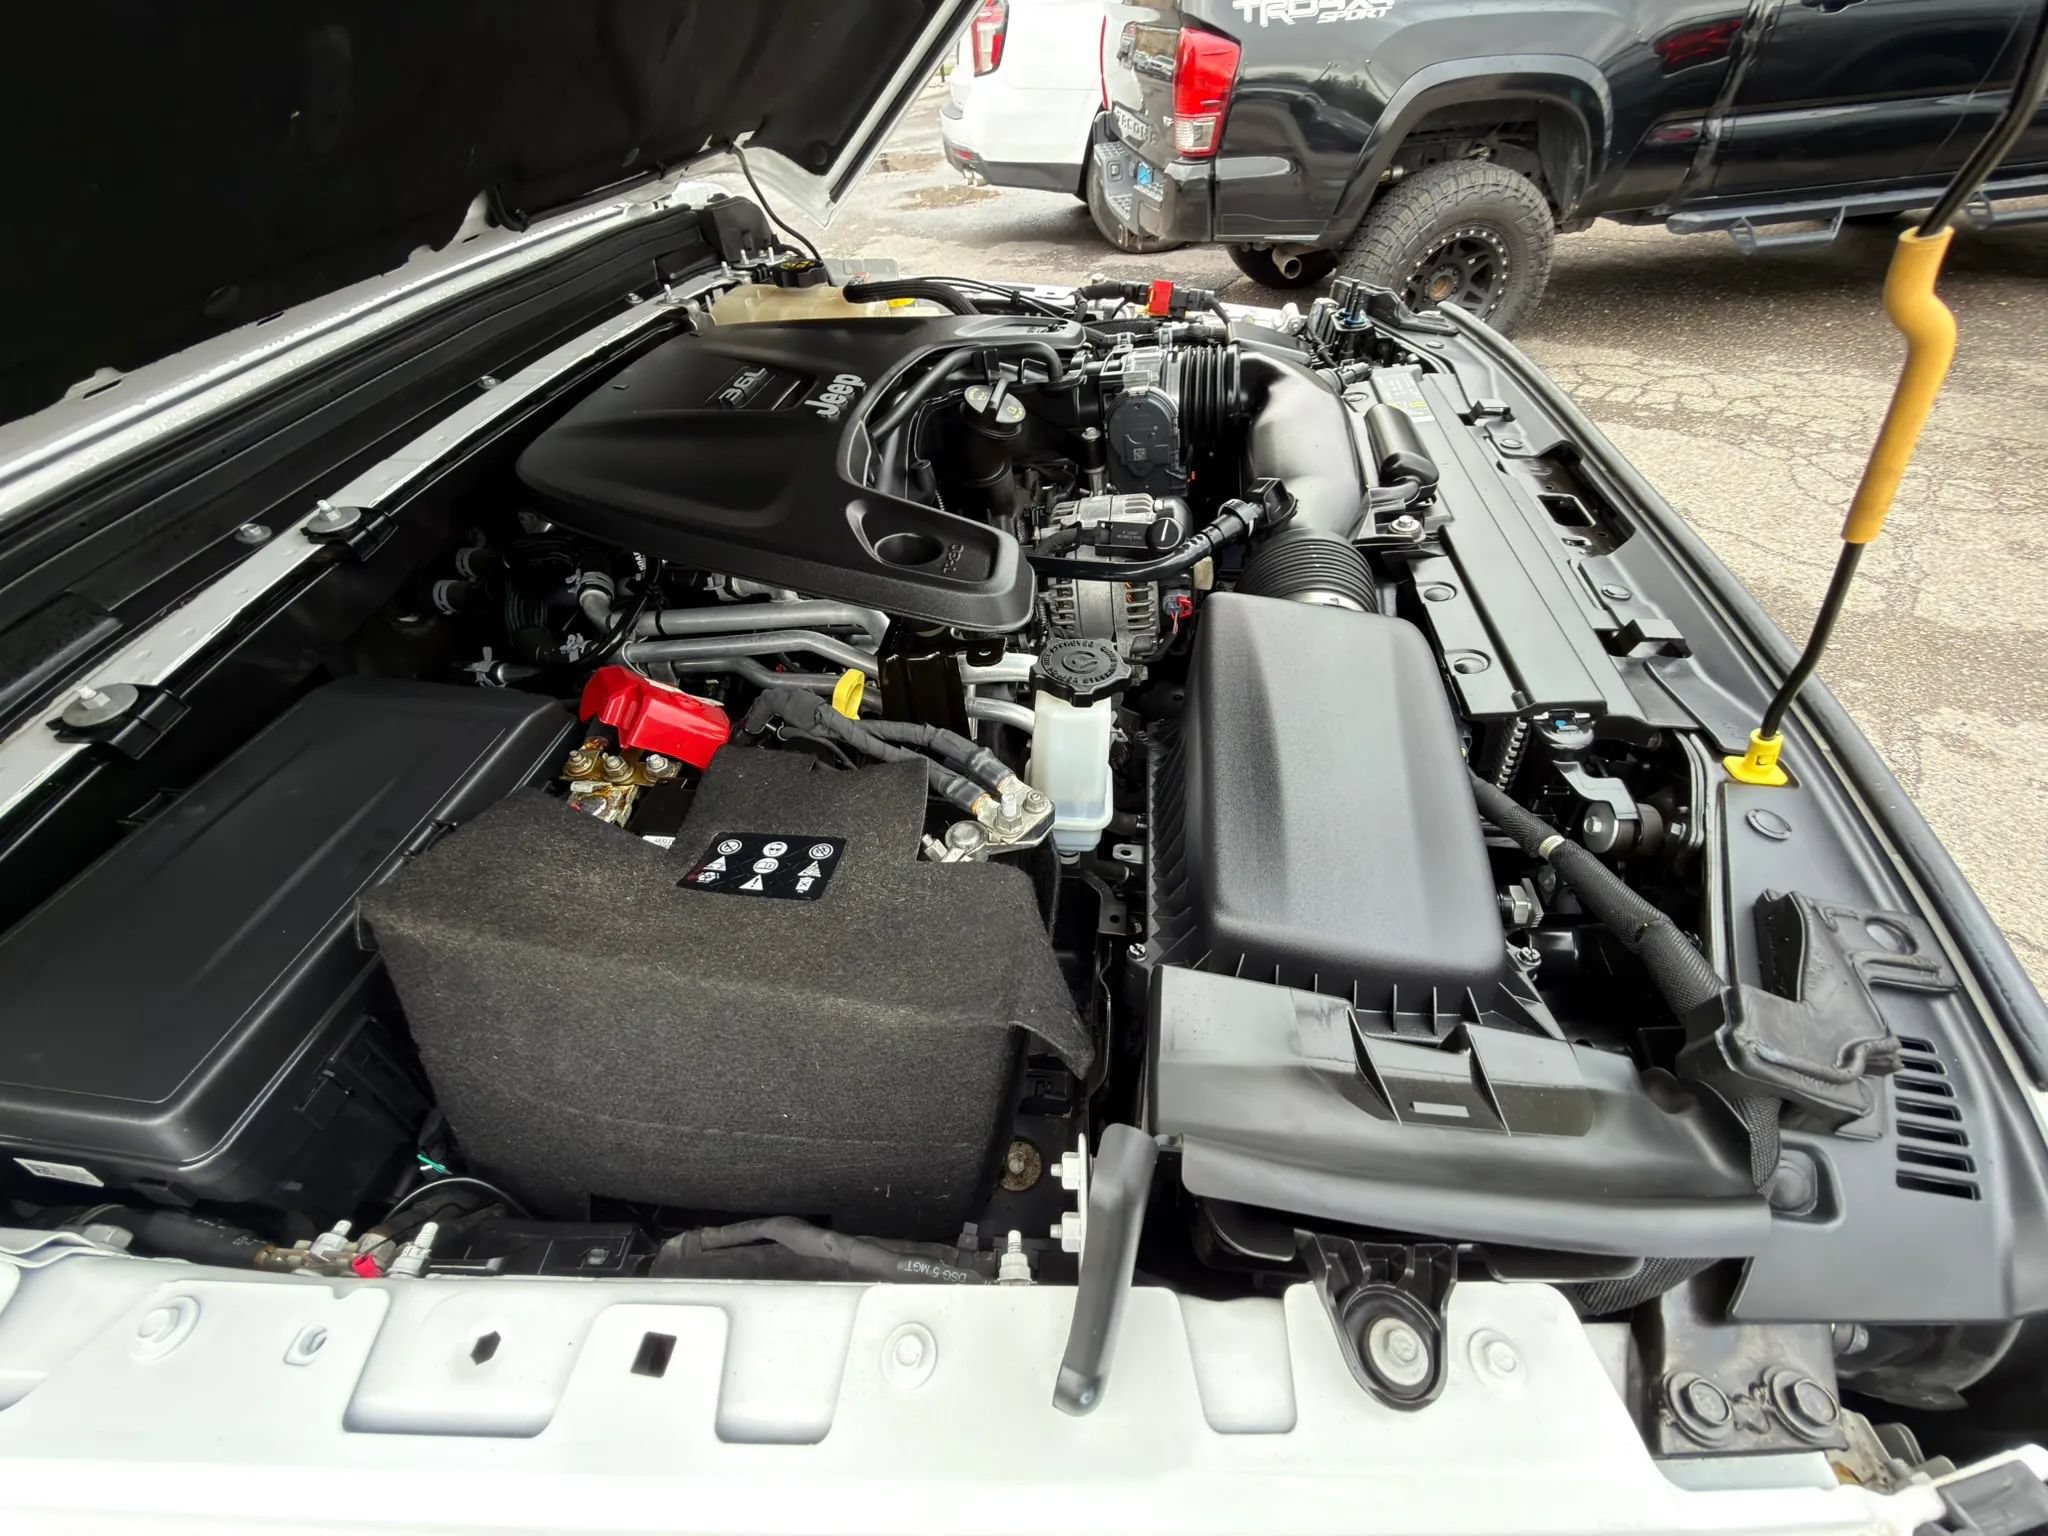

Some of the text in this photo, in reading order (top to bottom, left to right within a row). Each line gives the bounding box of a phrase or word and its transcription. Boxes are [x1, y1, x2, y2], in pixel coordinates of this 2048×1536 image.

[1232, 0, 1319, 28] TRD
[1317, 7, 1394, 25] SPORT
[804, 373, 867, 419] Jeep
[903, 1259, 968, 1284] DSG 5 MGT
